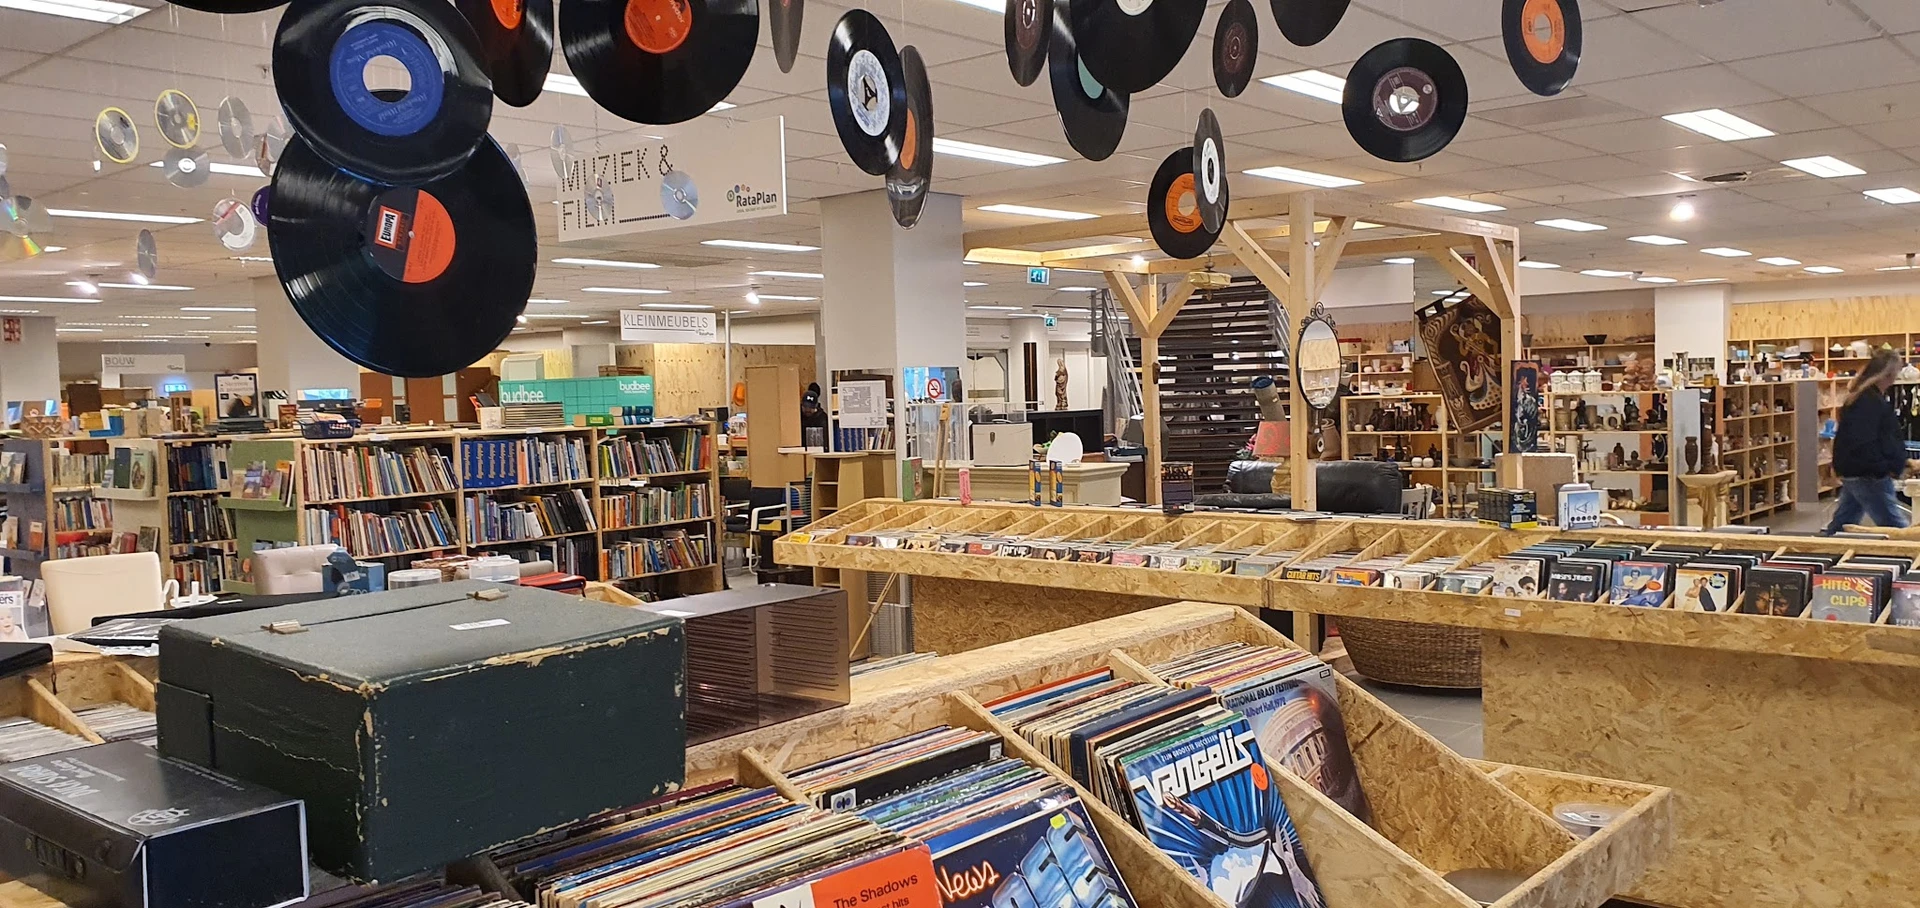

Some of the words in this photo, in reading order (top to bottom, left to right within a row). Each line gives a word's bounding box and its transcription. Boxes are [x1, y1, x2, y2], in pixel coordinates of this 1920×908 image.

[658, 144, 674, 177] &
[735, 192, 777, 207] RataPlan
[380, 213, 397, 242] EUROPA
[623, 314, 709, 329] KLEINMEUBELS
[104, 356, 136, 366] BOUW
[619, 380, 651, 391] budbee
[500, 384, 545, 403] budbee
[1822, 579, 1851, 591] HITS
[1830, 595, 1867, 607] CLIPS
[1225, 692, 1257, 710] NATIONAL
[1257, 685, 1276, 701] BRASS
[1275, 679, 1300, 694] FESTIVAL
[1245, 704, 1264, 718] Albert
[833, 896, 858, 908] The
[860, 874, 919, 903] Shadows
[892, 896, 910, 908] hits
